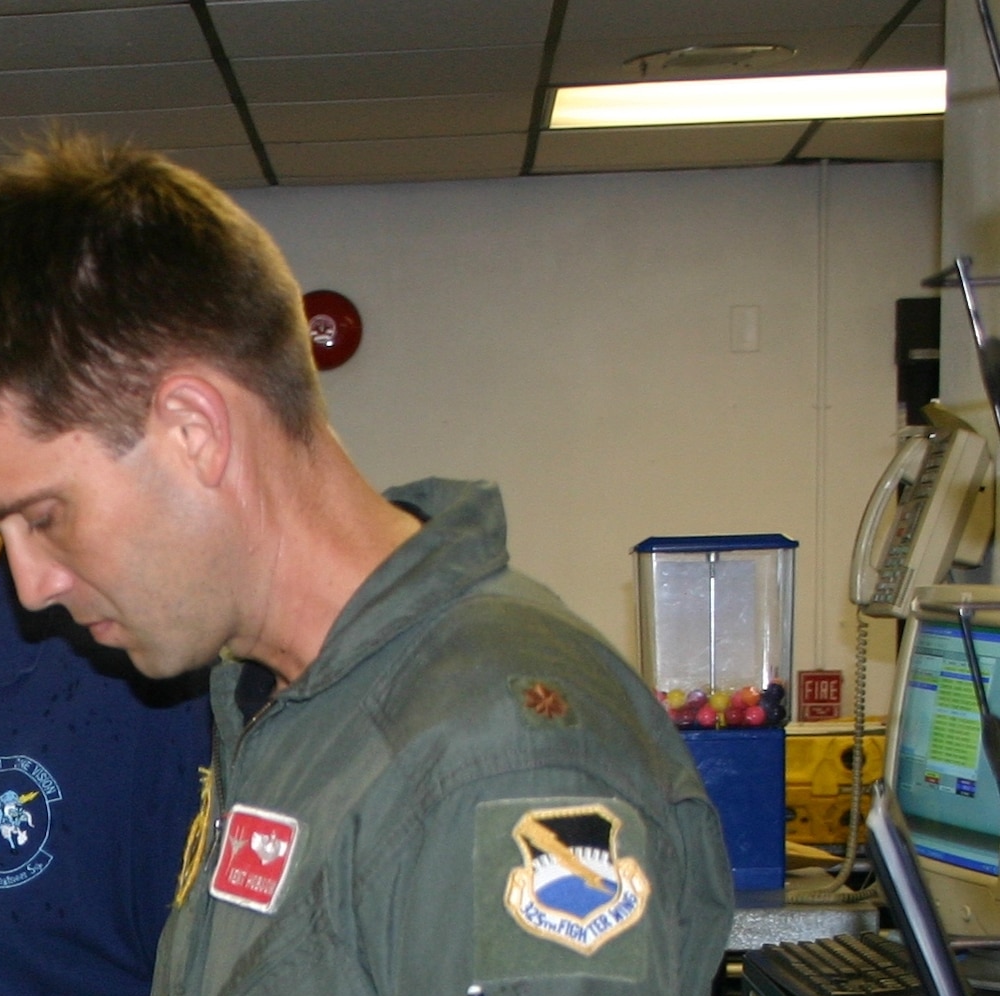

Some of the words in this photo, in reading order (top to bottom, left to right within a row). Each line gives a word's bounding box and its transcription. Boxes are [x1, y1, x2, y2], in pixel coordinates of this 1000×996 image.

[805, 680, 838, 700] FIRE
[32, 765, 56, 794] VISION
[521, 902, 557, 932] 325TH
[556, 918, 612, 943] FIGHTER
[609, 892, 638, 923] WING
